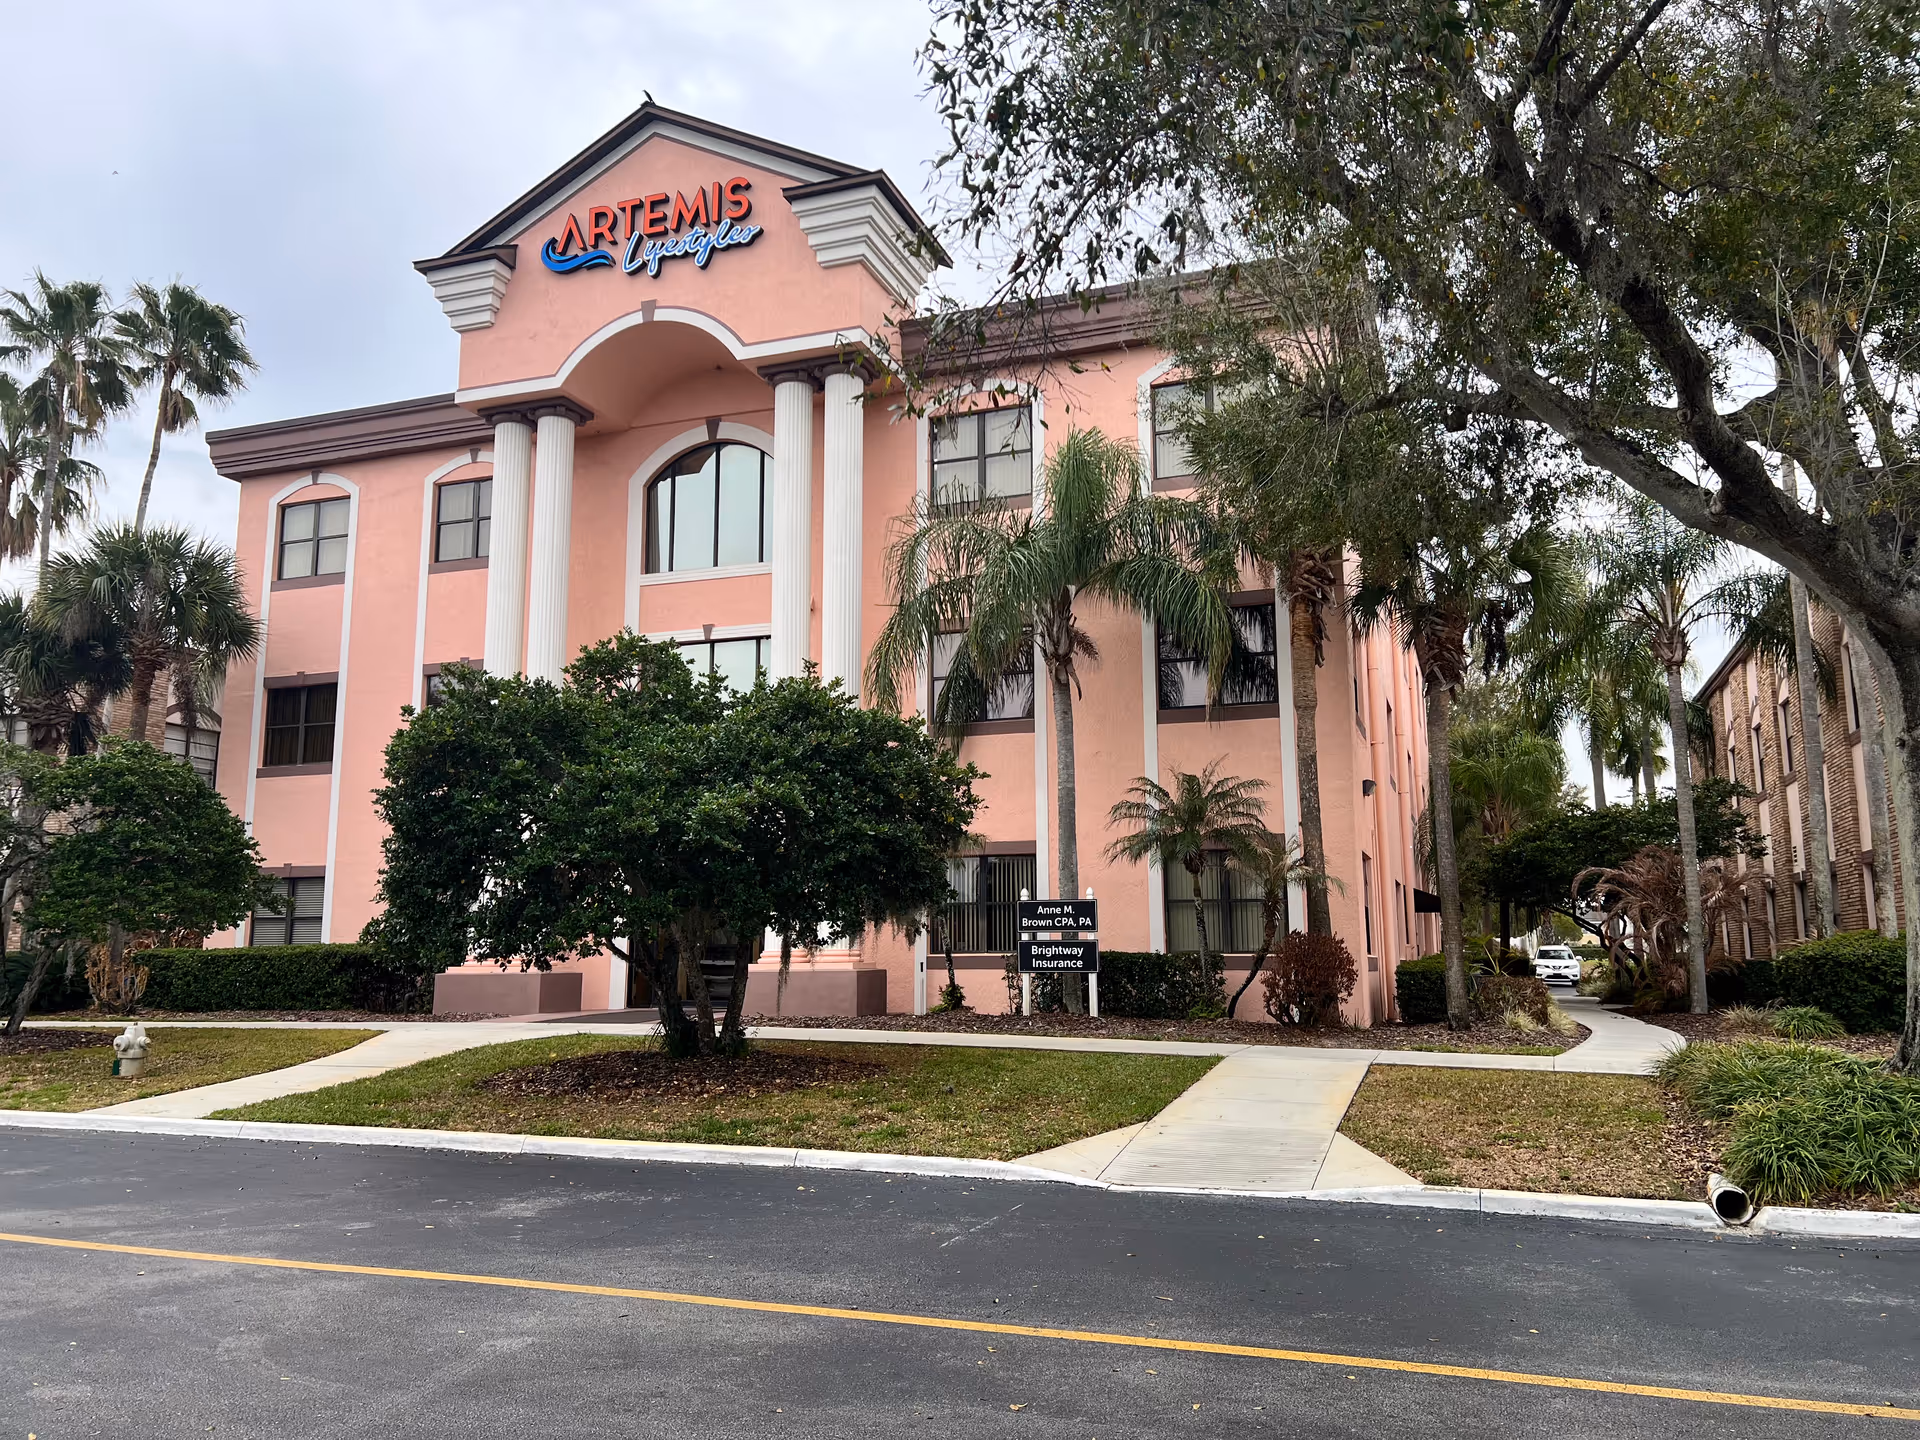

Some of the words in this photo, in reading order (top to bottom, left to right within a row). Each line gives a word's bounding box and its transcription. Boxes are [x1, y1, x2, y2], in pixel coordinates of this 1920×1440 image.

[557, 177, 752, 253] ARTEMIS
[1037, 905, 1061, 914] Anne
[1064, 905, 1075, 914] M.
[1022, 917, 1052, 927] Brown
[1054, 917, 1077, 927] CPA,
[1079, 917, 1092, 926] PA
[1031, 945, 1084, 957] Brightway
[1032, 958, 1083, 968] Insurance
